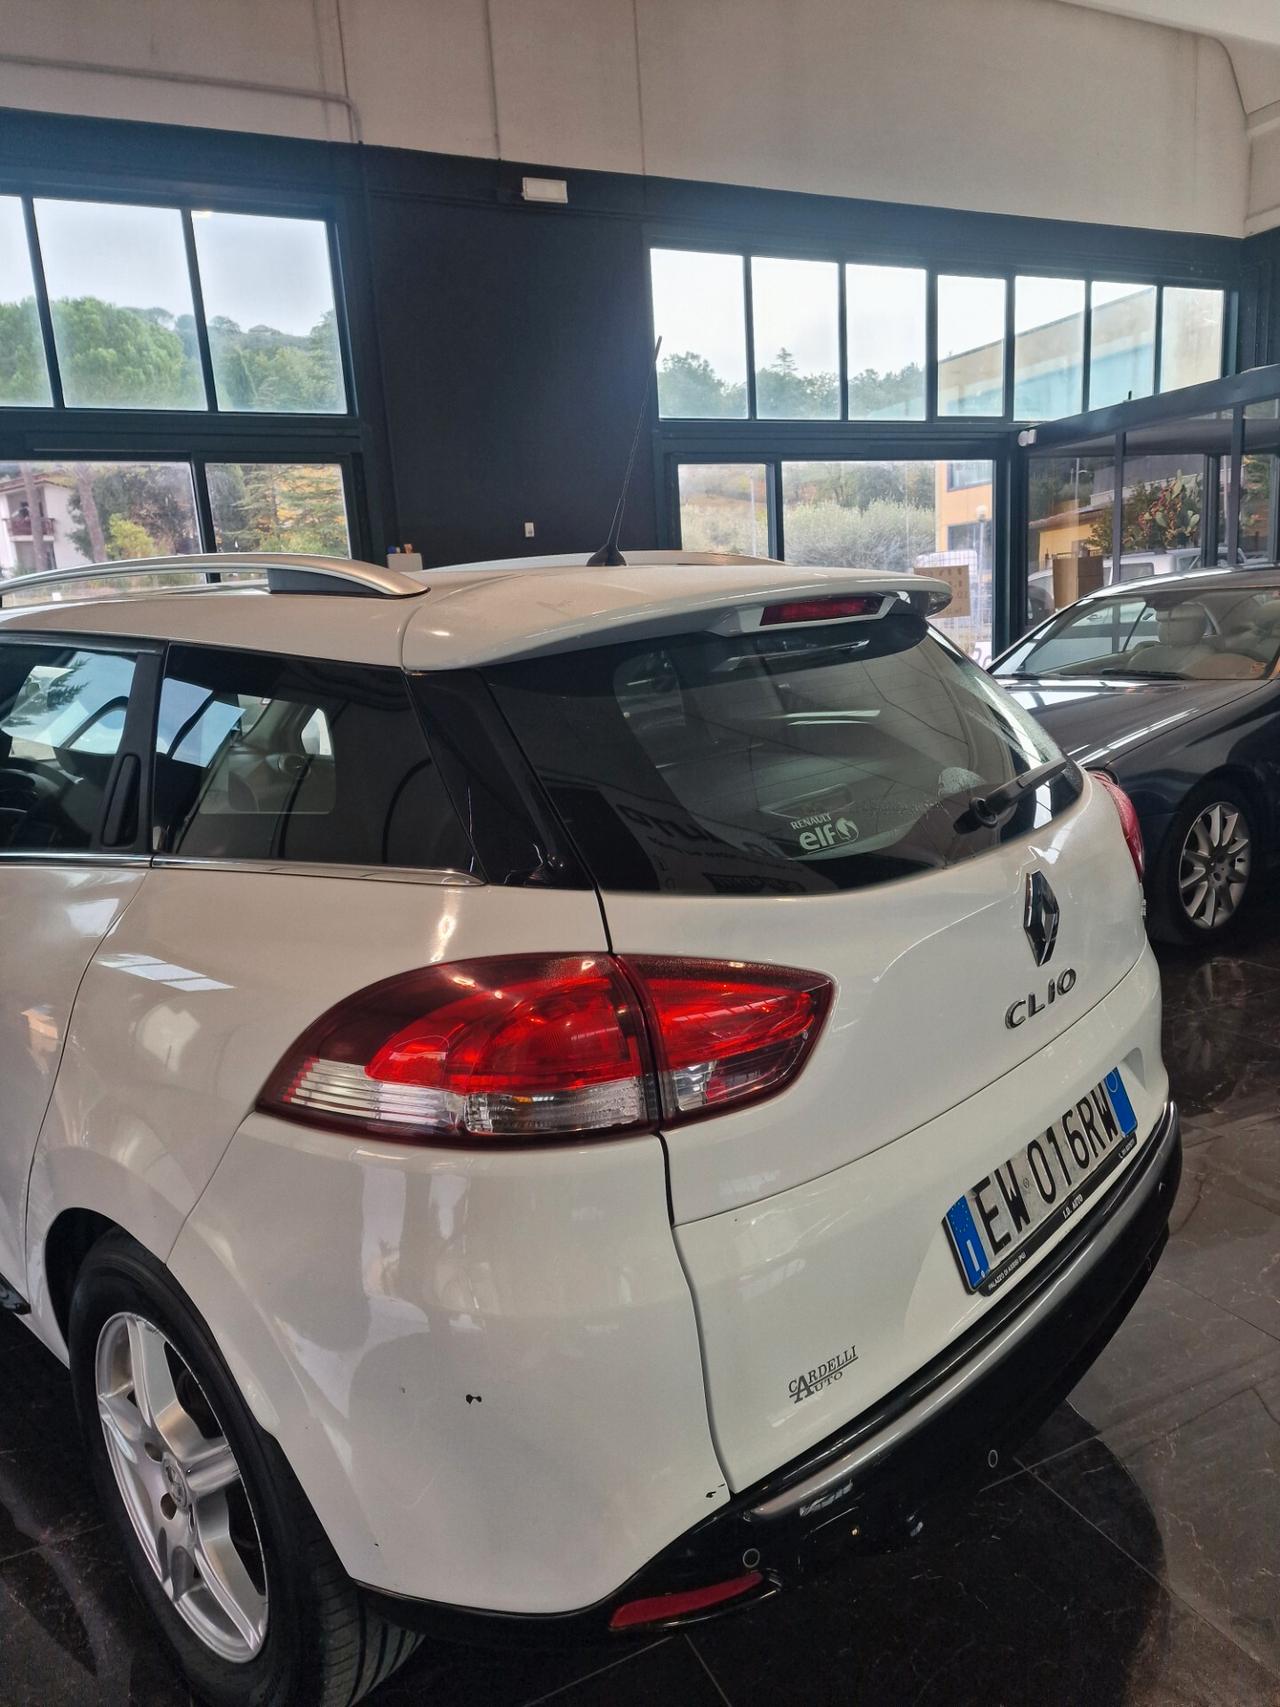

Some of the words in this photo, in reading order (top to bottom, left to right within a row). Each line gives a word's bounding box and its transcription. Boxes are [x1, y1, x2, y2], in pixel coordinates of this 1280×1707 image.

[790, 812, 832, 830] RENAULT
[799, 823, 836, 850] elf
[1005, 967, 1077, 1029] CLIO
[788, 1345, 857, 1404] CARDELLI
